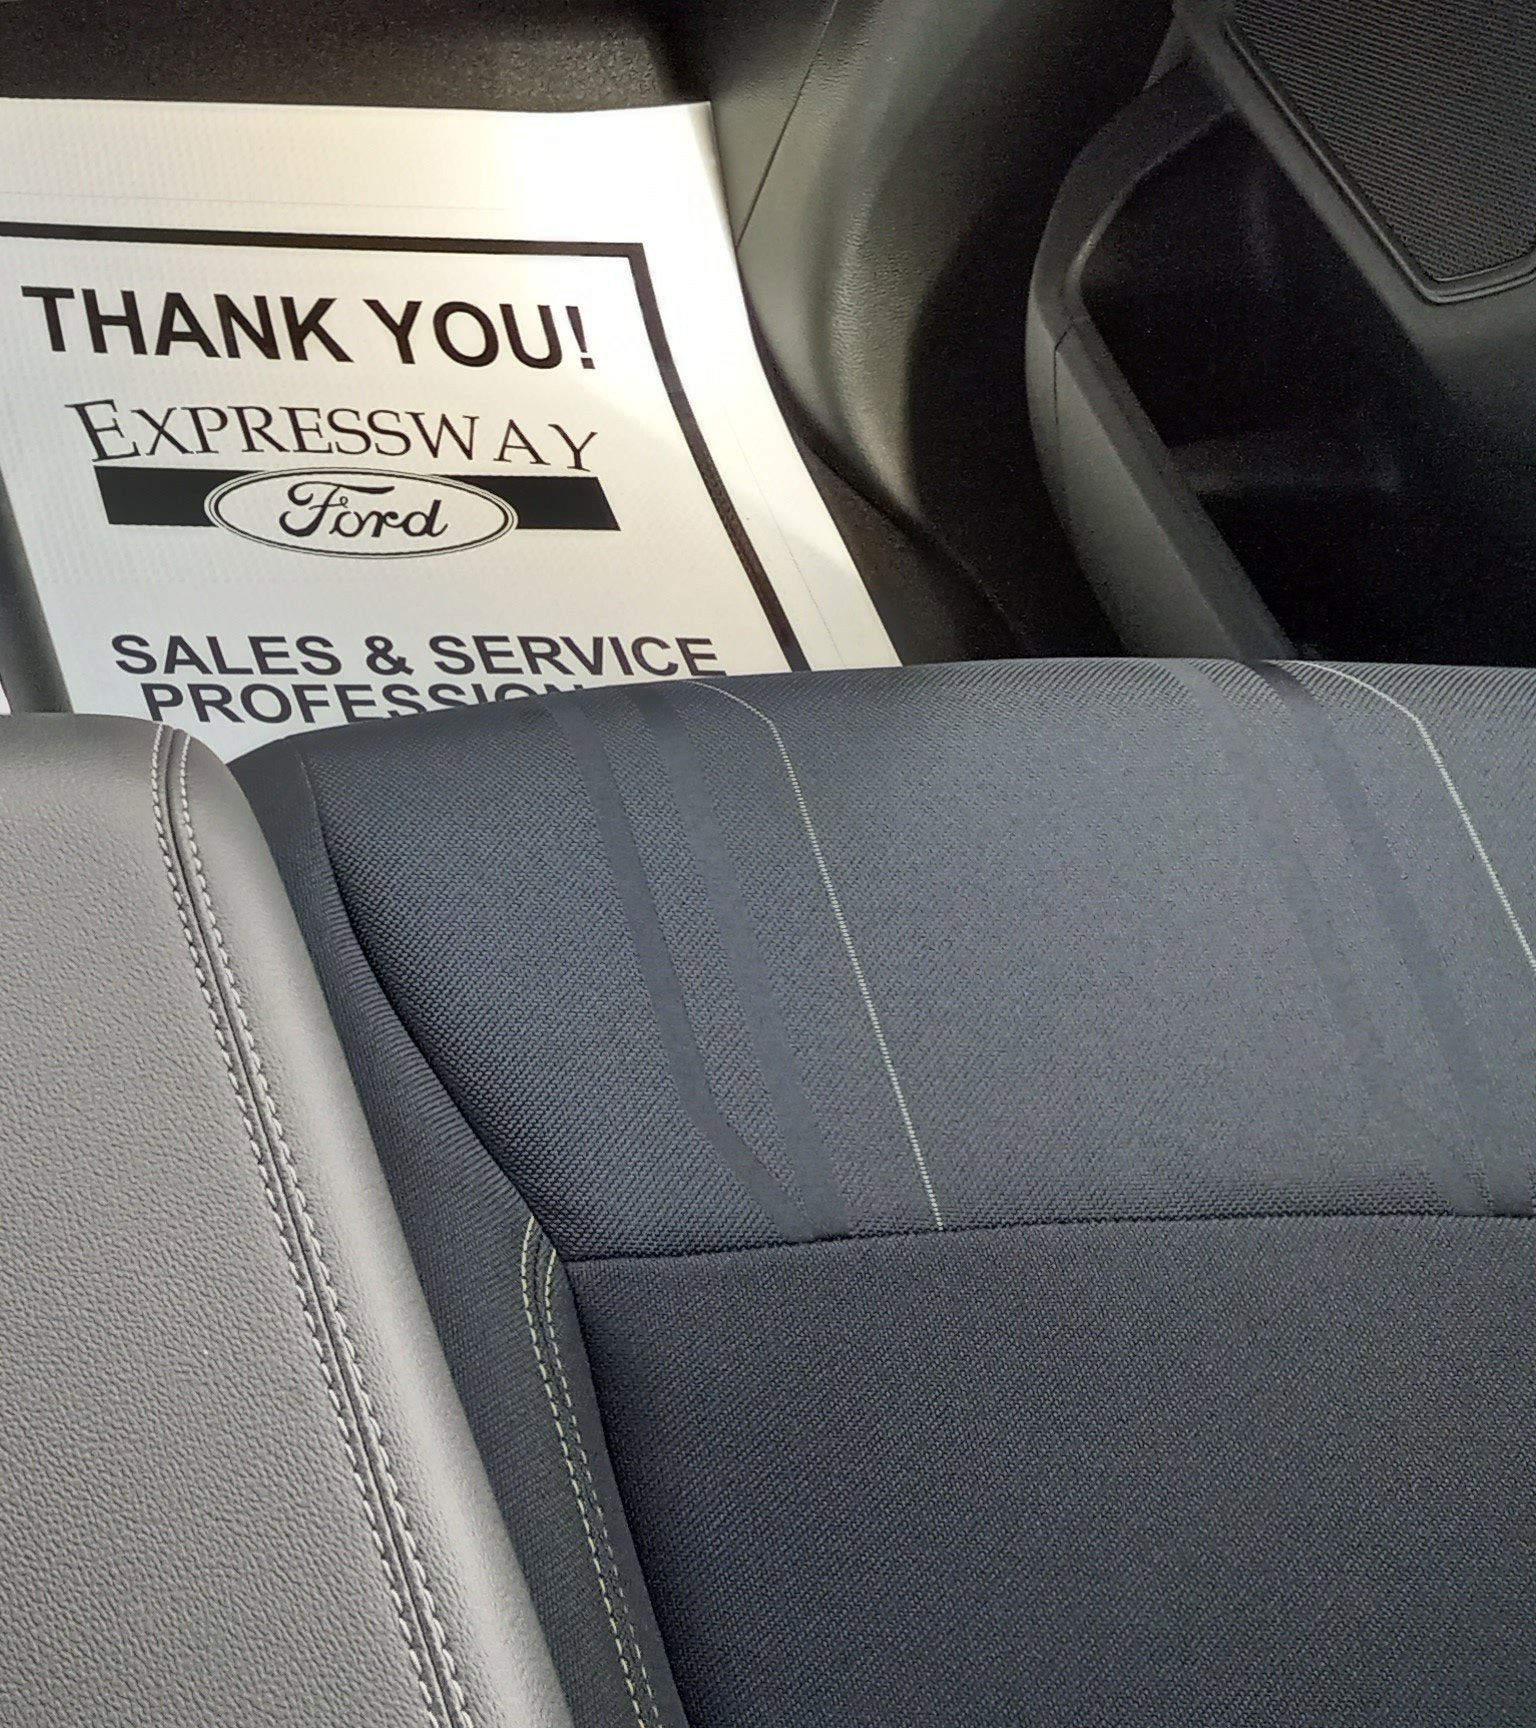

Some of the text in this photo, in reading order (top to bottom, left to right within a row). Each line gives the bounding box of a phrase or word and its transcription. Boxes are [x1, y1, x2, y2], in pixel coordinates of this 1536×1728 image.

[20, 284, 597, 372] THANK YOU!
[63, 397, 601, 475] EXPRESSWAY
[277, 480, 451, 542] Ford
[109, 633, 727, 678] SALES & SERVICE
